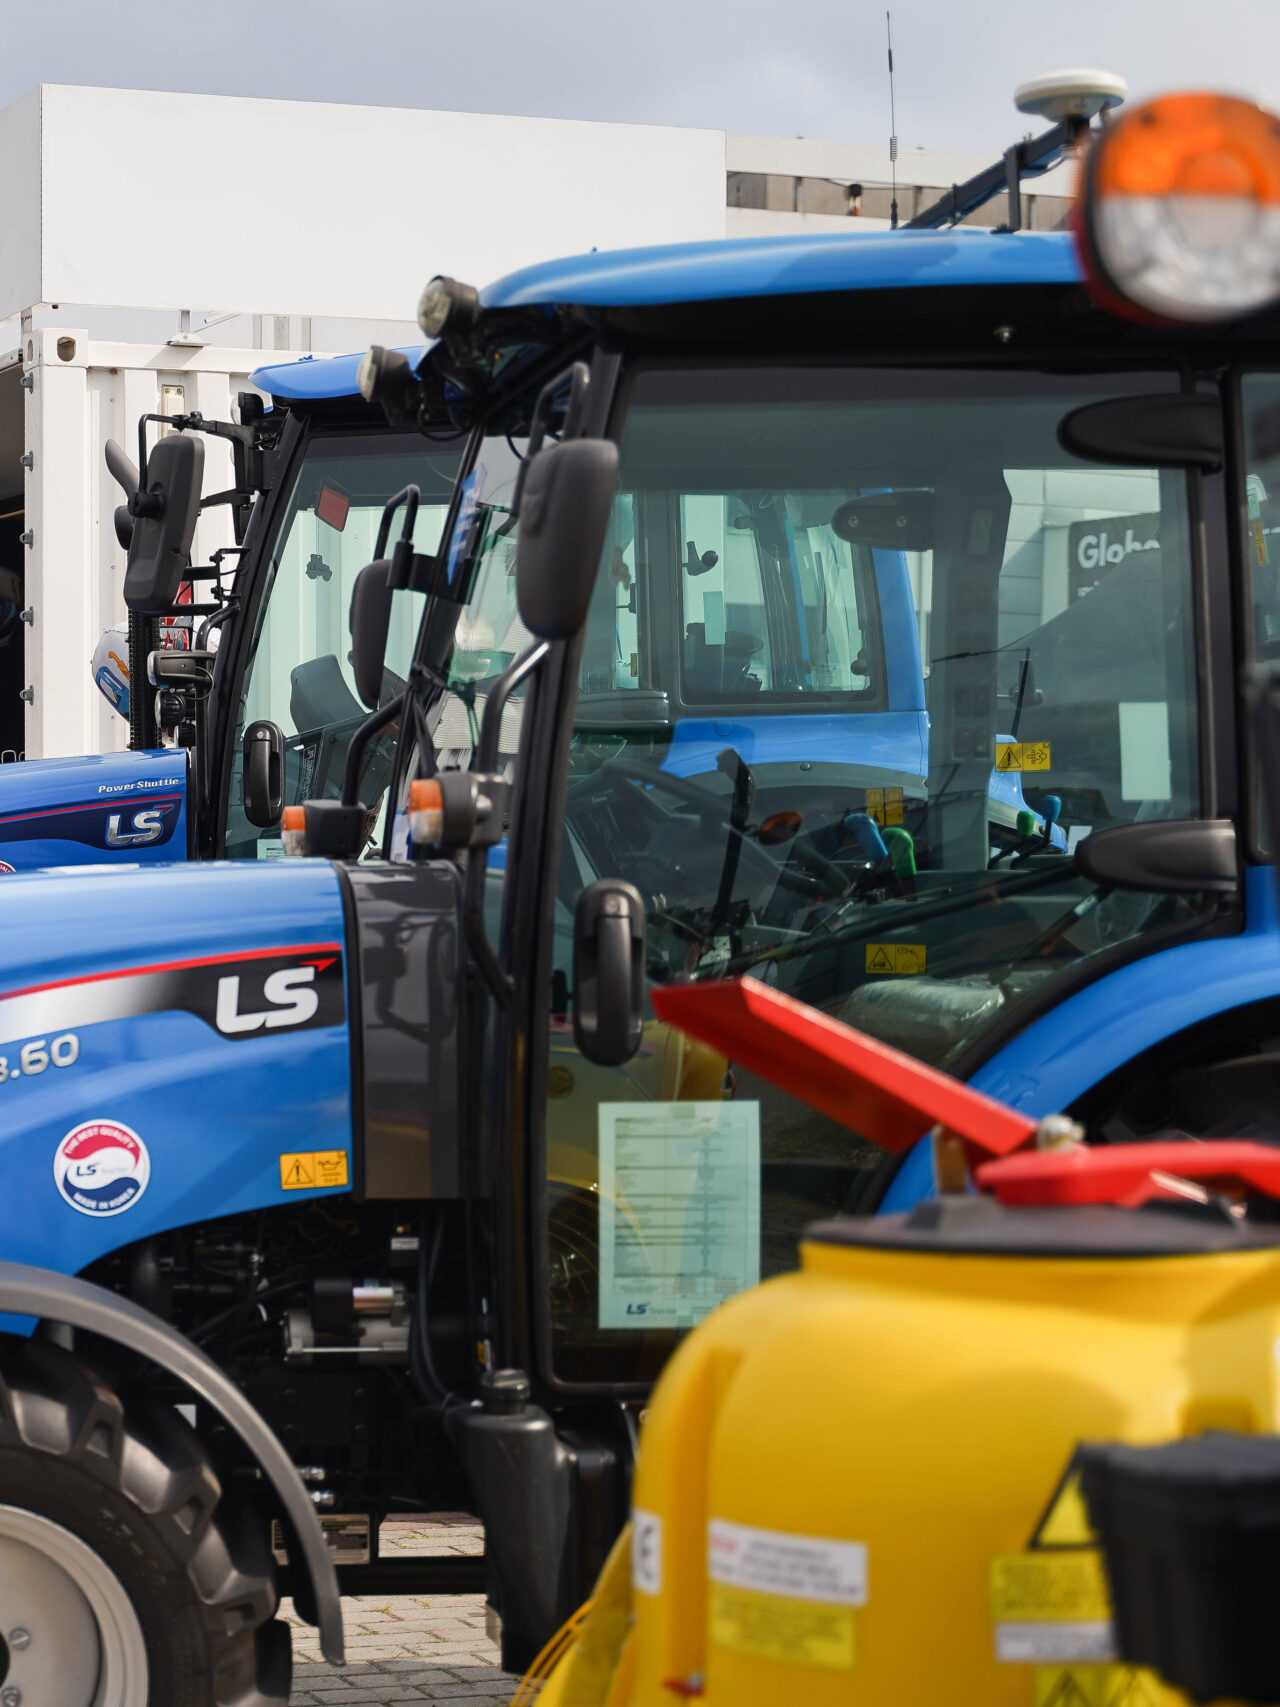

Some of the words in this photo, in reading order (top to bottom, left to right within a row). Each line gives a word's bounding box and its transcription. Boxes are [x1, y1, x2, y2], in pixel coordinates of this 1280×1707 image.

[98, 783, 136, 793] Power
[136, 778, 179, 790] Shuttle
[108, 810, 163, 845] LS
[216, 966, 319, 1034] LS
[77, 1126, 99, 1141] BEST
[99, 1126, 136, 1149] QUALITY
[76, 1163, 97, 1177] LS
[73, 1191, 97, 1209] MADE
[97, 1201, 110, 1210] IN
[108, 1186, 135, 1208] KOREA
[626, 1303, 648, 1316] LS
